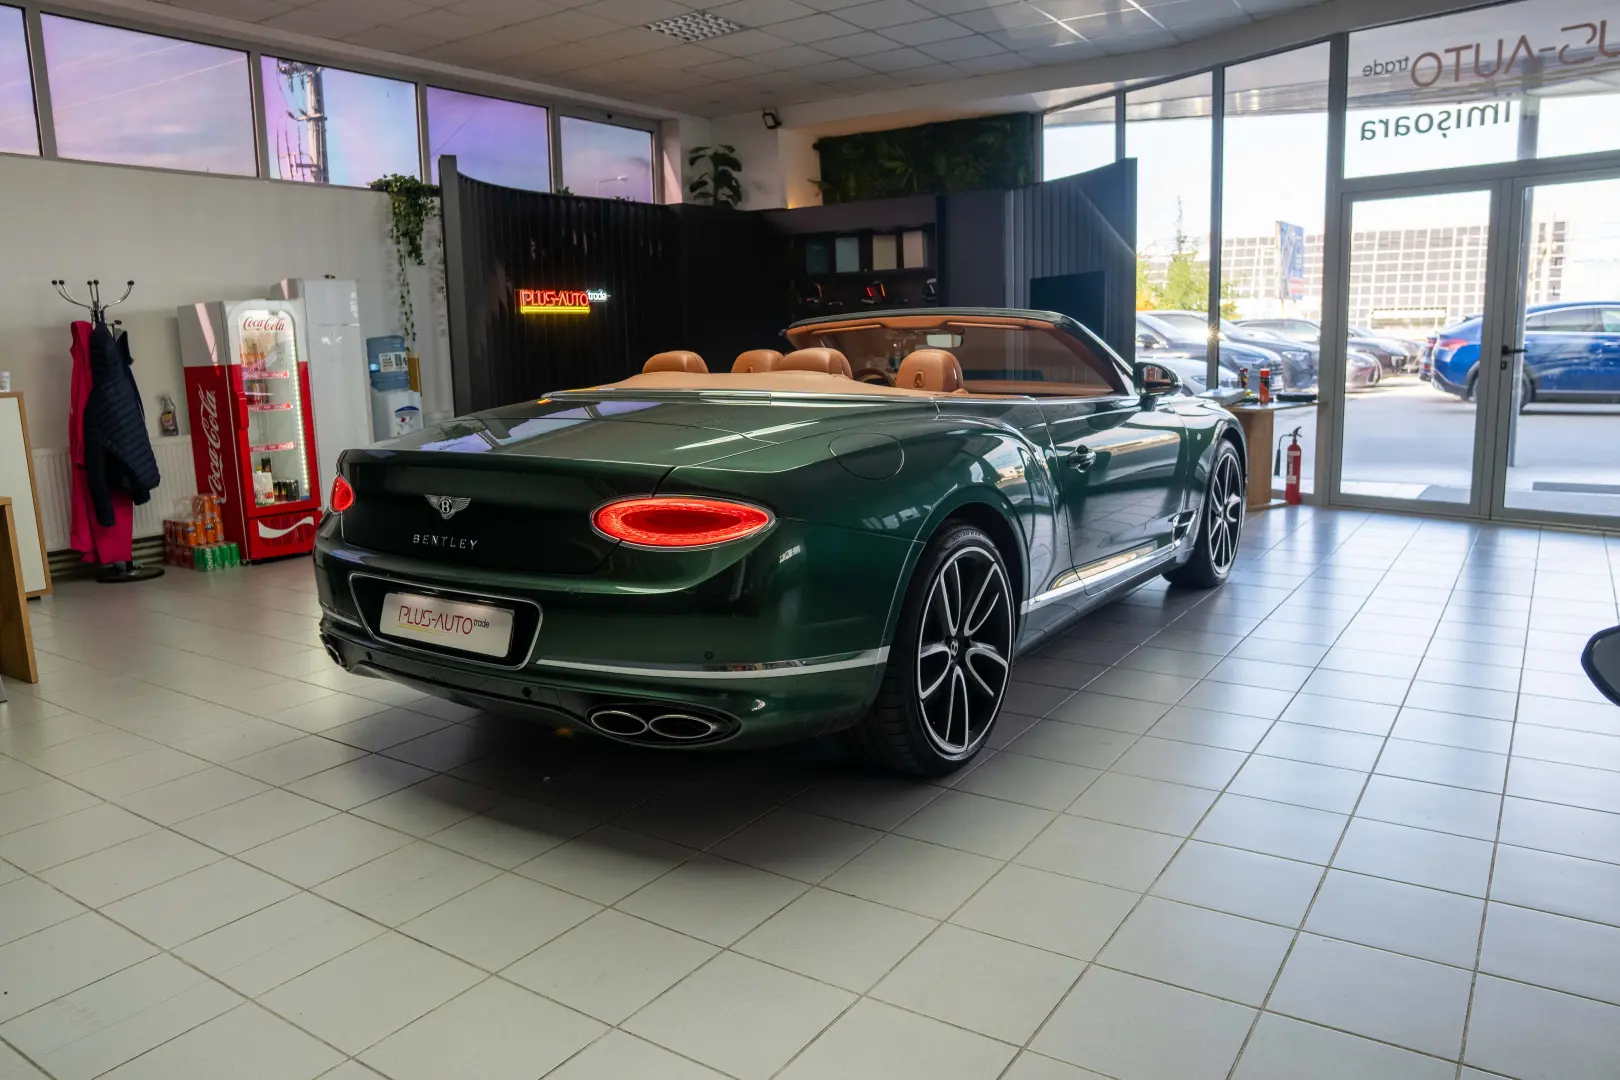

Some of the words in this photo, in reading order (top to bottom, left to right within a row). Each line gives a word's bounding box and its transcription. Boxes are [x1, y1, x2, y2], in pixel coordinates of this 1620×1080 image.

[521, 290, 588, 307] PLUS-AUTO
[586, 289, 608, 302] trade
[412, 533, 478, 550] BENTLEY
[399, 605, 473, 635] PLUS-AUTO
[473, 618, 490, 629] trade
